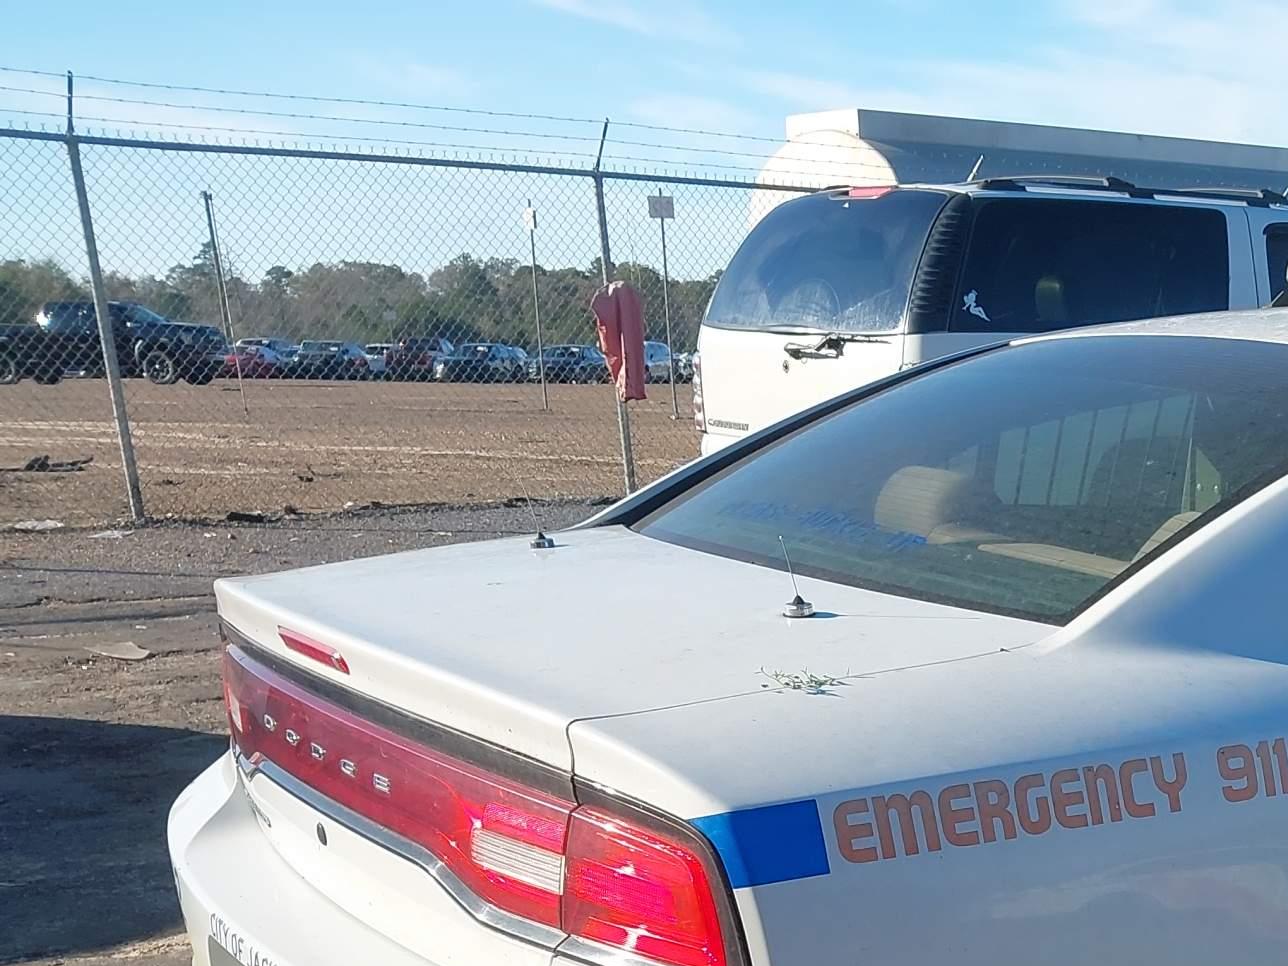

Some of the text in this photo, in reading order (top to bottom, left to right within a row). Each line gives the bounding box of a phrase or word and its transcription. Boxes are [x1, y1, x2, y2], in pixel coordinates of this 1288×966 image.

[264, 714, 391, 794] DODGE
[833, 752, 1188, 864] EMERGENCY
[210, 913, 230, 950] CITY
[231, 933, 244, 960] OF
